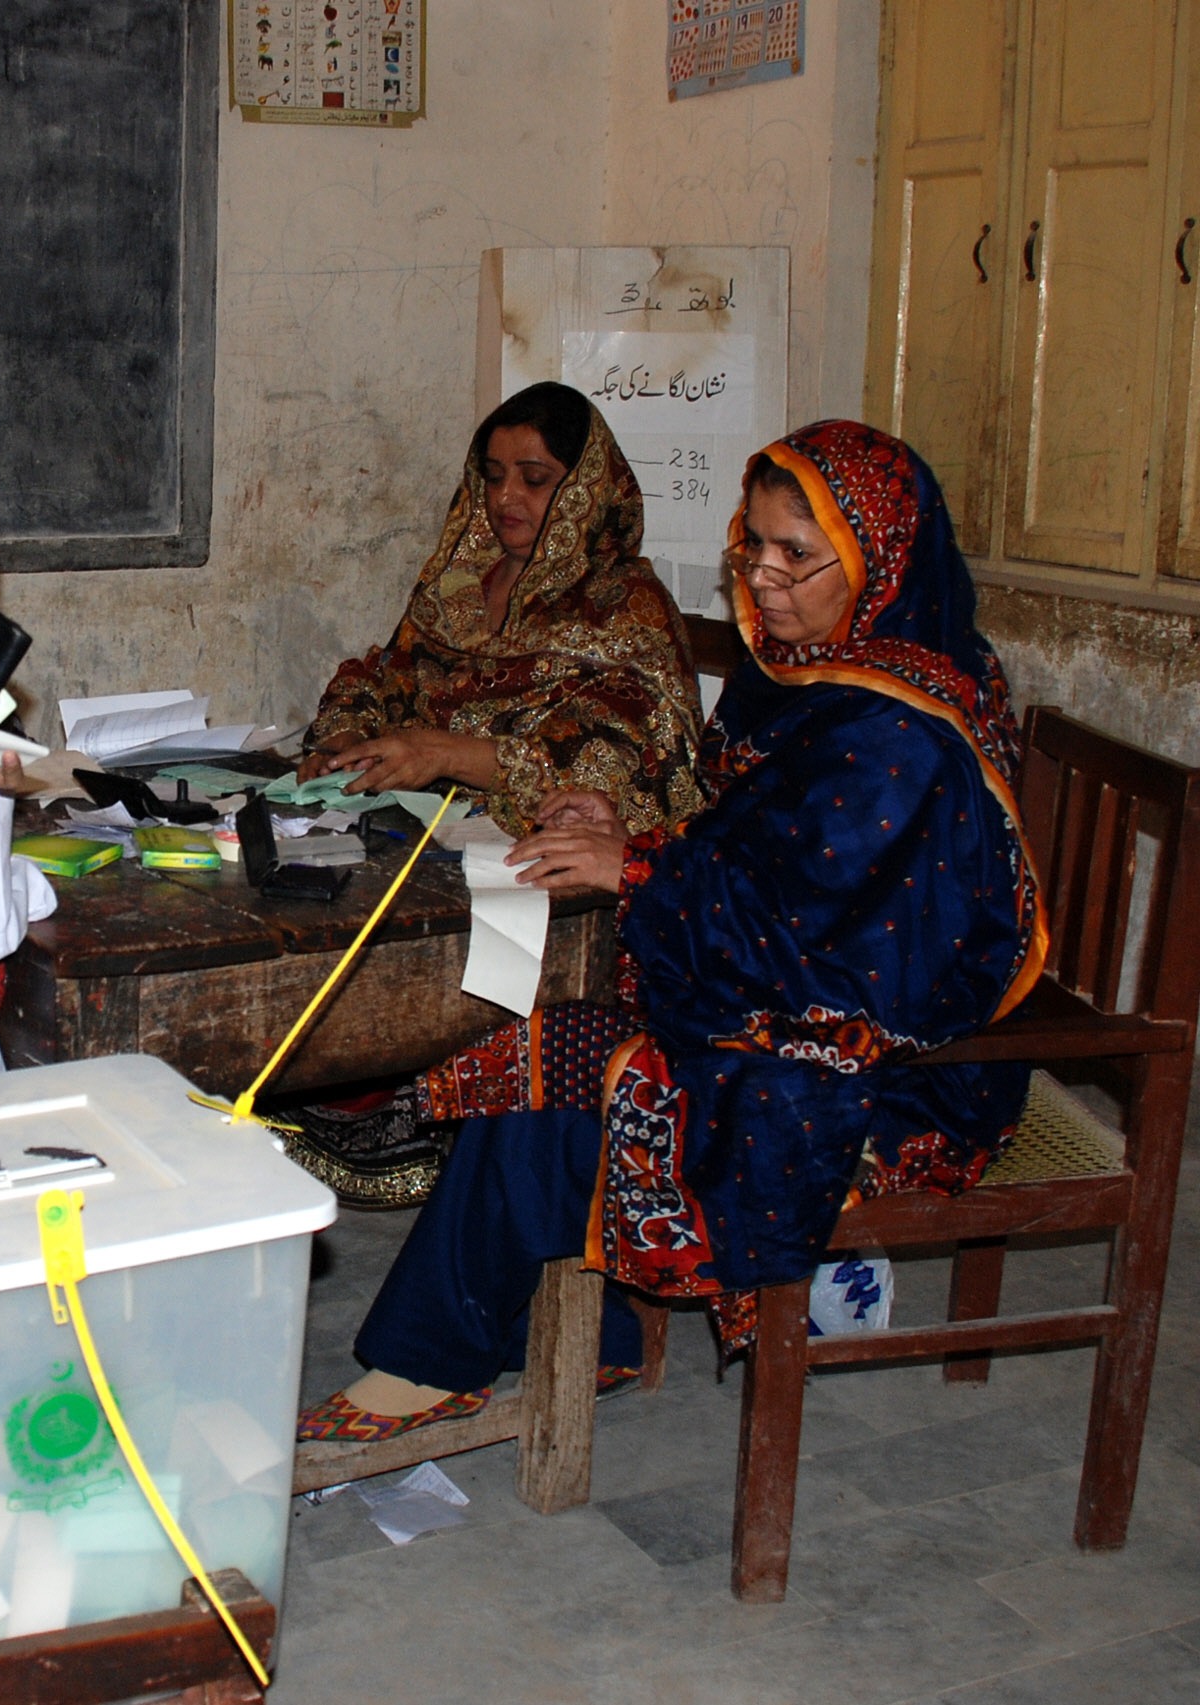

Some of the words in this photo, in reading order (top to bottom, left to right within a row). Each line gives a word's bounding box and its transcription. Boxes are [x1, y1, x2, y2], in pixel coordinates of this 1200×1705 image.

[736, 14, 749, 32] 19
[767, 6, 784, 25] 20
[673, 30, 685, 48] 17
[704, 22, 717, 39] 18
[591, 364, 621, 401] جگہ
[619, 364, 645, 401] کی
[686, 372, 726, 402] نشان
[668, 448, 710, 471] 231
[672, 478, 711, 507] 384
